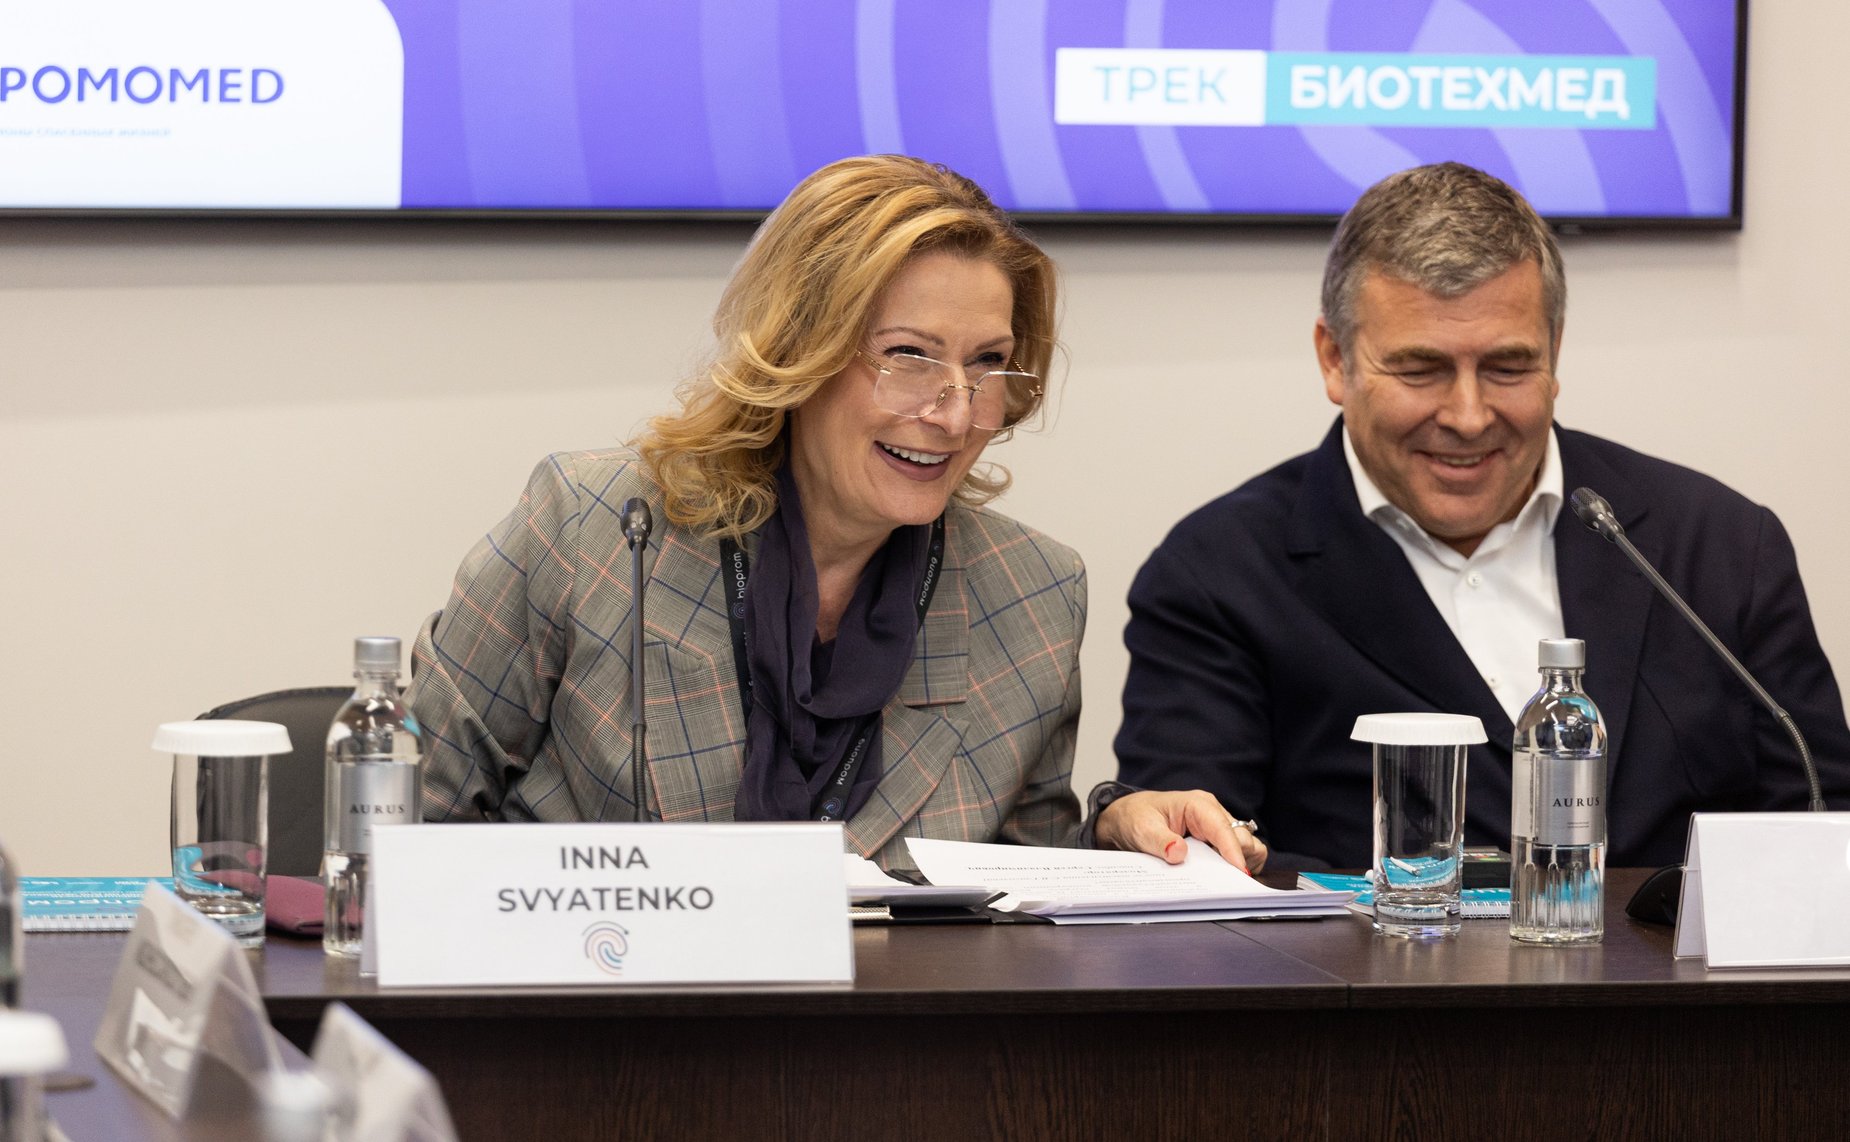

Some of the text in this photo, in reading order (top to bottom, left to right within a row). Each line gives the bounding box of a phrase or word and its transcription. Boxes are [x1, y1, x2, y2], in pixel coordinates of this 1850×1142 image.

[1093, 64, 1630, 119] ТРЕК БИОТЕХМЕД
[349, 803, 405, 814] AURUS
[1552, 796, 1600, 808] AURUS
[560, 846, 650, 870] INNA
[498, 886, 715, 913] SVYATENKO
